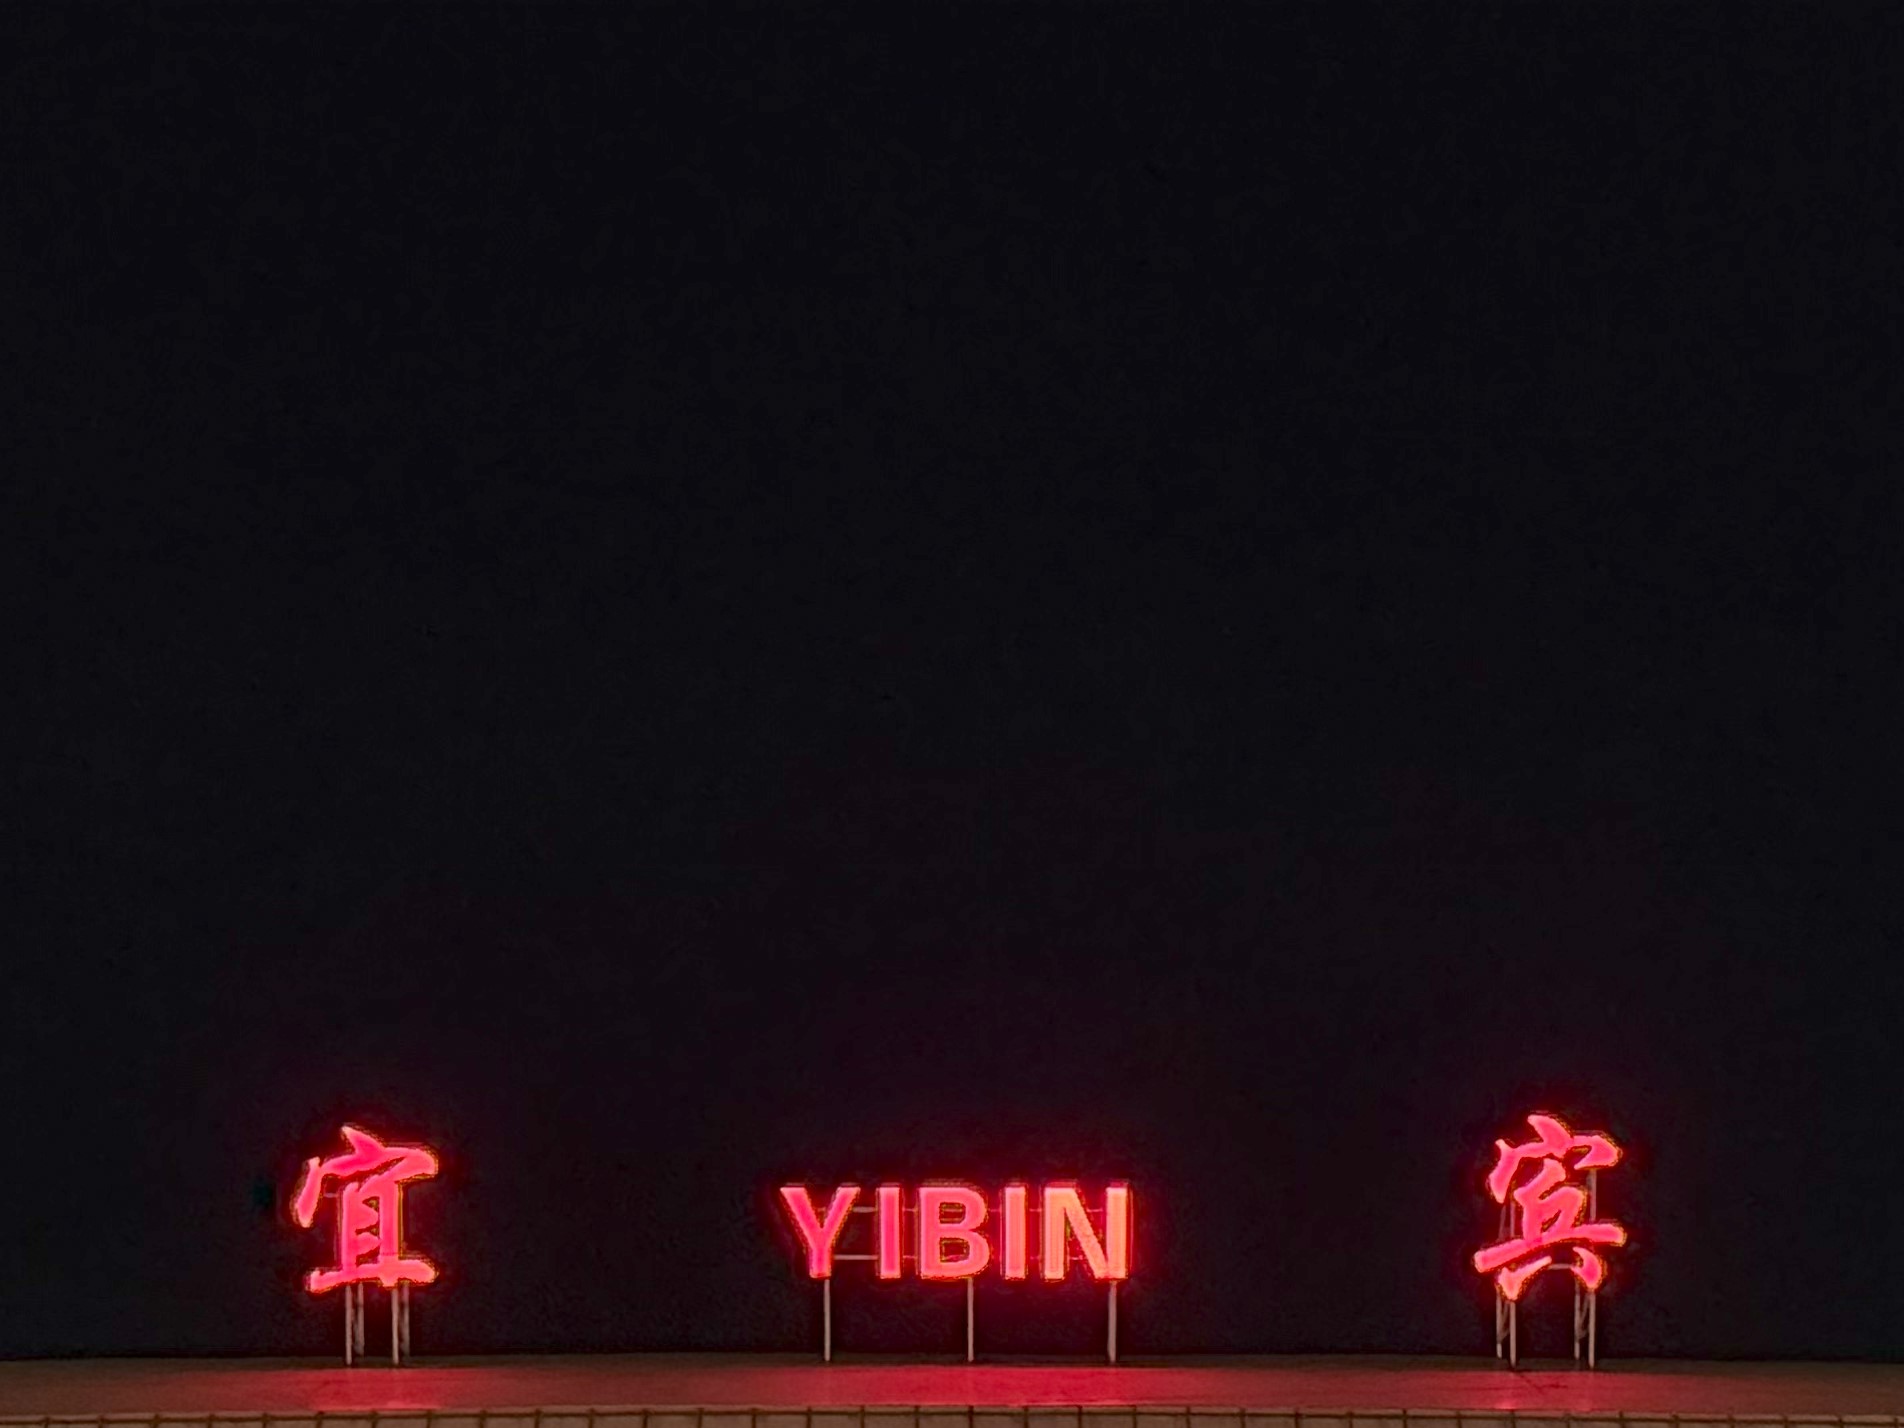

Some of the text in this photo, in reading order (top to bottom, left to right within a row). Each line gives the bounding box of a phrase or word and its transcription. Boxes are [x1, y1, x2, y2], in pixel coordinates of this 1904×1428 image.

[294, 1125, 439, 1293] 宜
[780, 1183, 1133, 1281] YIBIN
[1475, 1114, 1628, 1299] 宾
